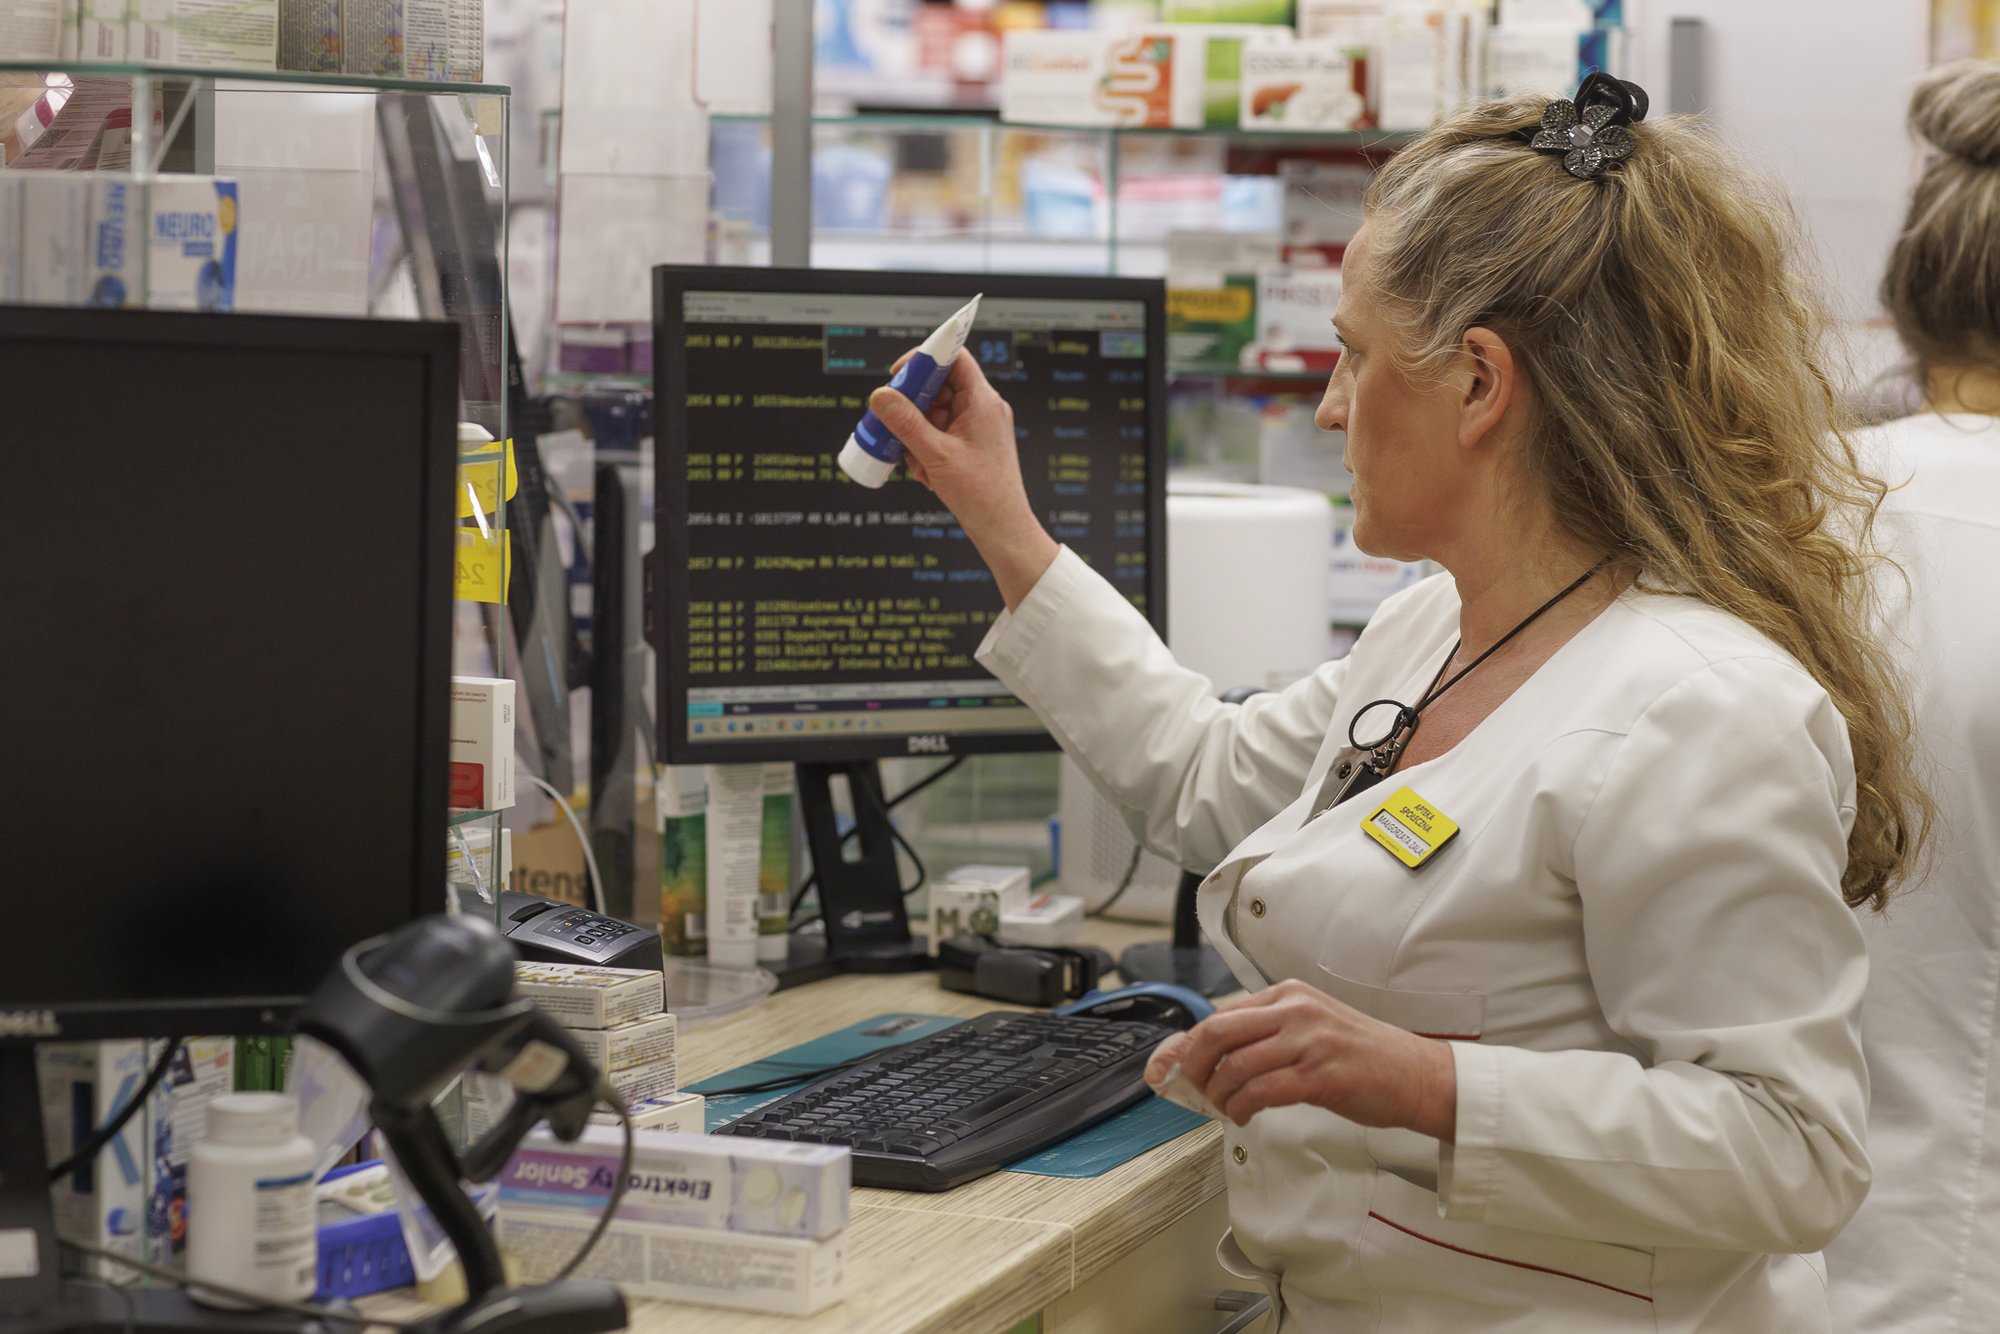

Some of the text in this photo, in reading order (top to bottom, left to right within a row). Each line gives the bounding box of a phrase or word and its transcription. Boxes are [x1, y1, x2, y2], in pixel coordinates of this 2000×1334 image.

[156, 211, 214, 239] NEURO
[979, 341, 1008, 364] 95
[908, 735, 949, 752] DELL
[1414, 803, 1435, 821] APTEKA
[515, 1161, 712, 1201] Elektroty Senior
